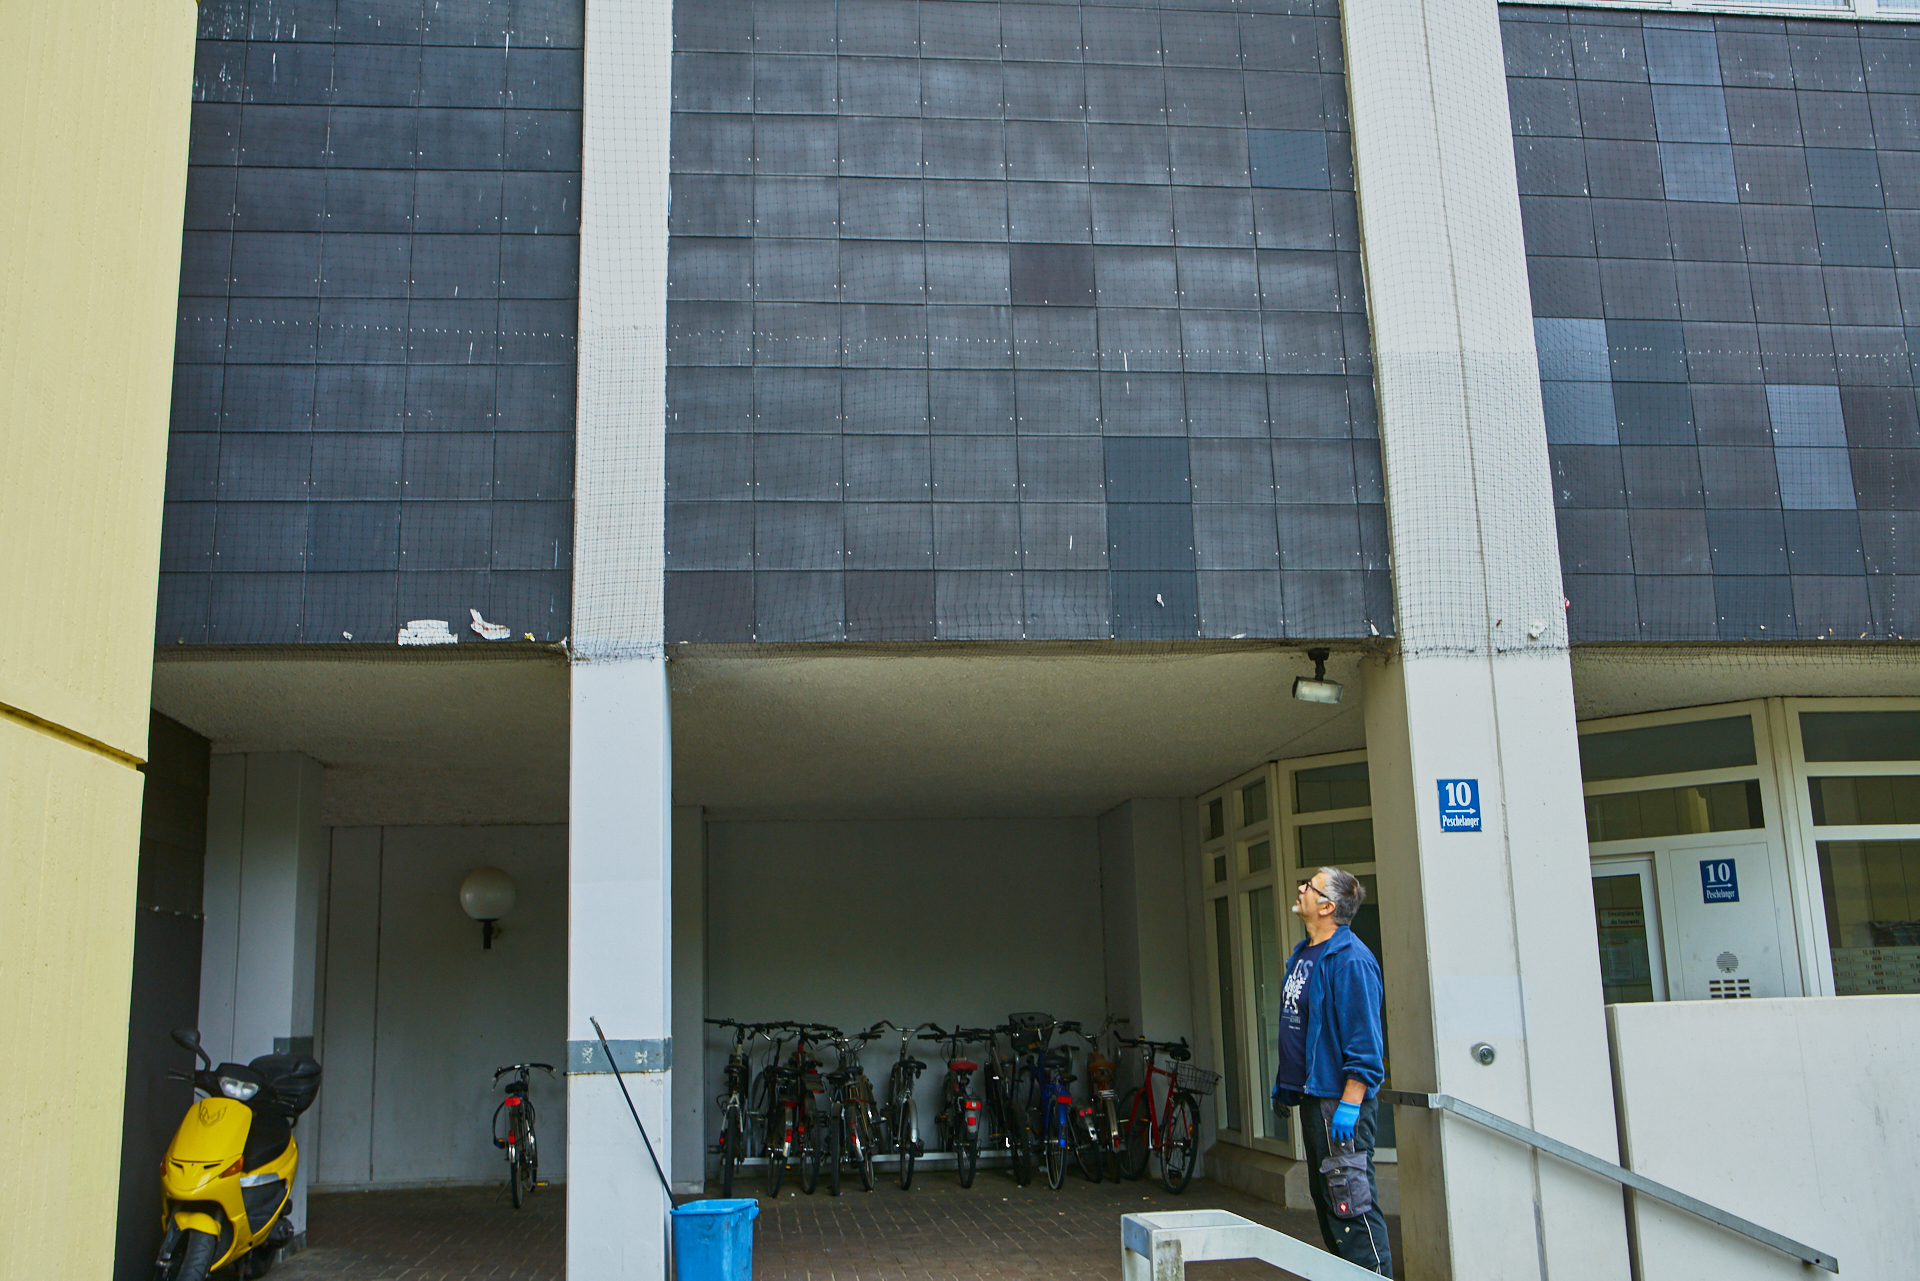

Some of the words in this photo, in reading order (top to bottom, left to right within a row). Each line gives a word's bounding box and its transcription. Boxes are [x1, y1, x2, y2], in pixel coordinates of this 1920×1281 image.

[1445, 781, 1472, 807] 10
[1442, 814, 1479, 828] Peschelanger
[1705, 862, 1731, 883] 10
[1706, 888, 1735, 900] Peschelanger
